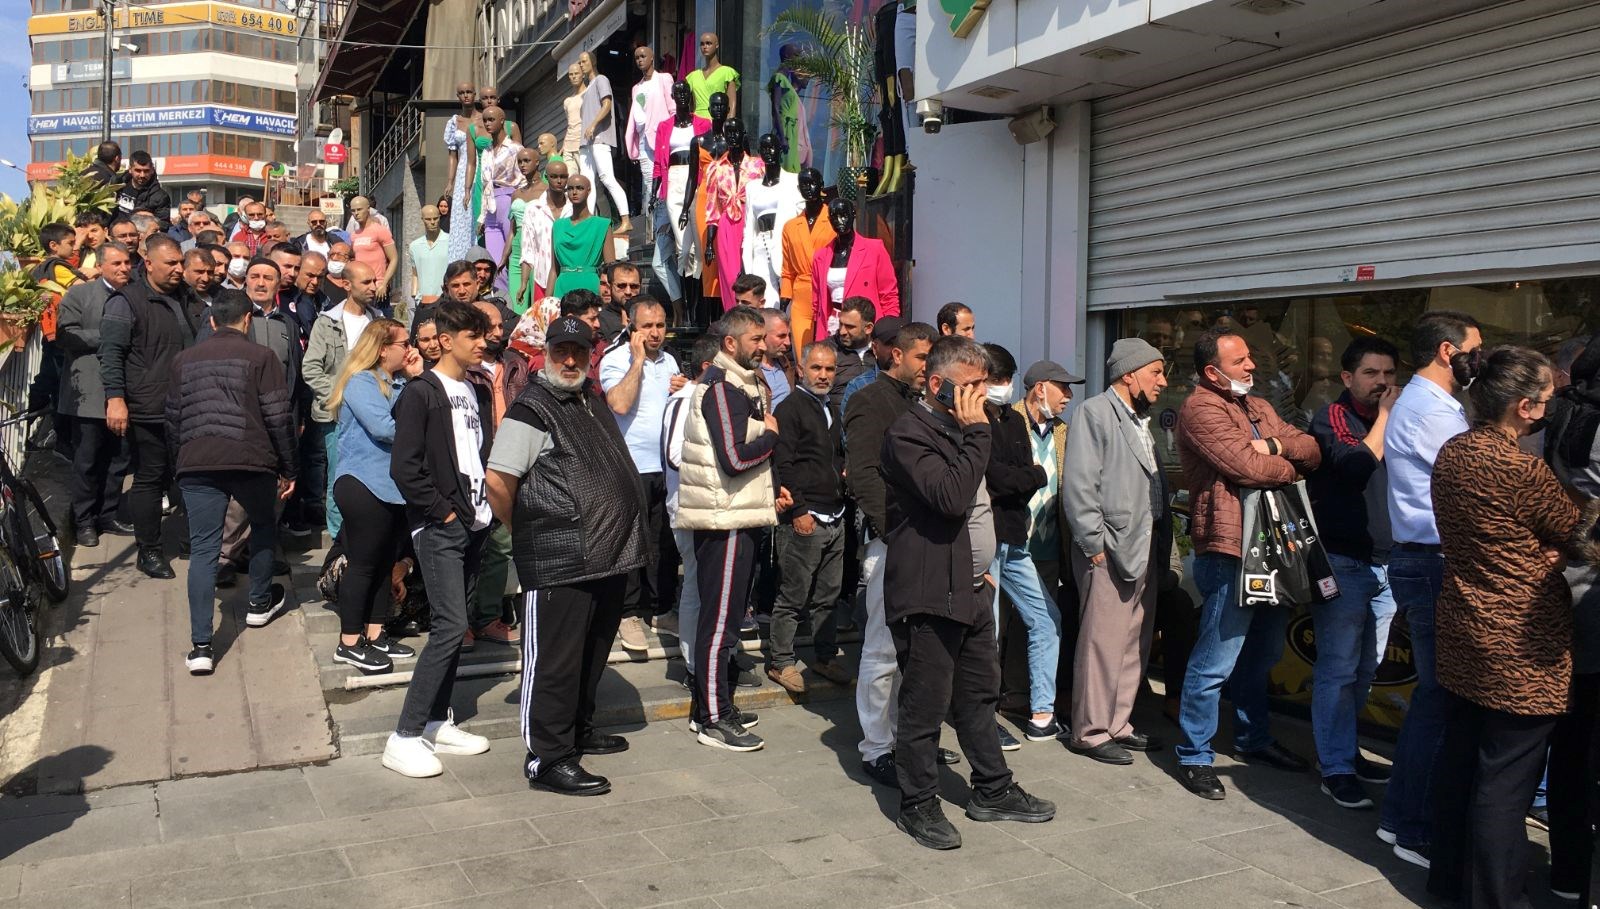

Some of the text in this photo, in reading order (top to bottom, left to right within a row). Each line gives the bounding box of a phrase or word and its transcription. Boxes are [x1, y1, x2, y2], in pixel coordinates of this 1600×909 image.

[68, 11, 164, 30] ENGLH TIME
[241, 13, 263, 29] 654
[268, 17, 282, 31] 40
[35, 108, 205, 129] HEM HAVACIK EĞİTİM MERKEZİ
[221, 113, 251, 125] HEM
